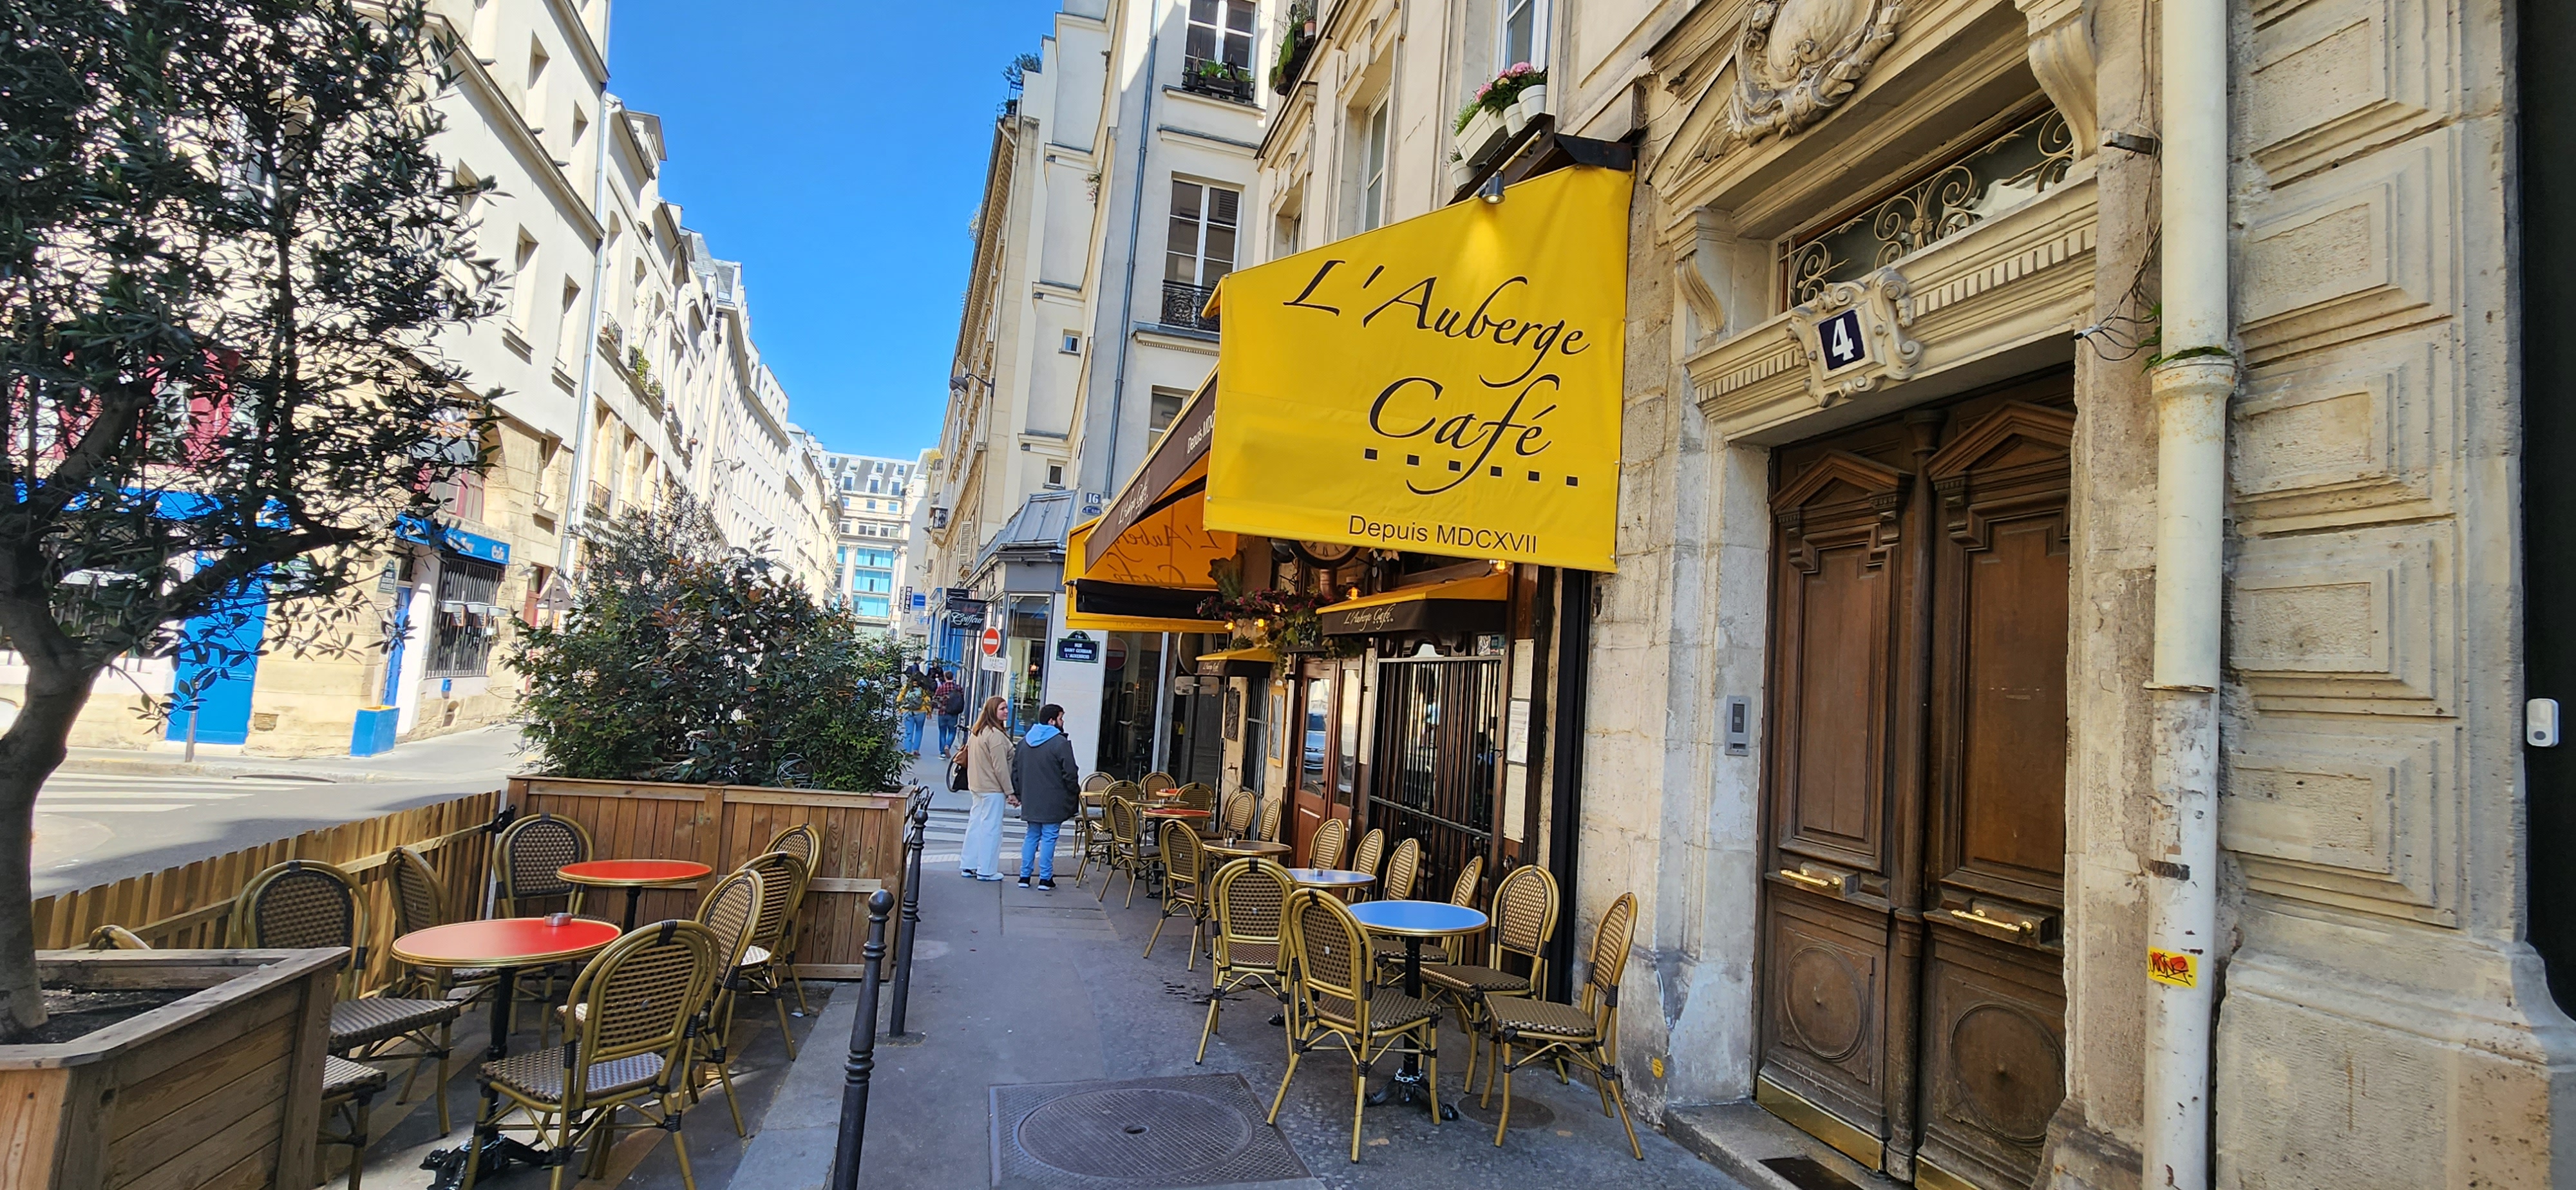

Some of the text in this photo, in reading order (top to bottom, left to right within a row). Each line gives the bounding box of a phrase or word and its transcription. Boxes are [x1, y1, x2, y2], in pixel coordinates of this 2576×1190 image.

[1832, 317, 1854, 361] 4
[1369, 374, 1560, 495] Café
[1088, 493, 1099, 504] 16
[1349, 515, 1537, 554] Depuis MDCXVII
[951, 612, 984, 625] Coiffeur
[1373, 603, 1396, 630] Café
